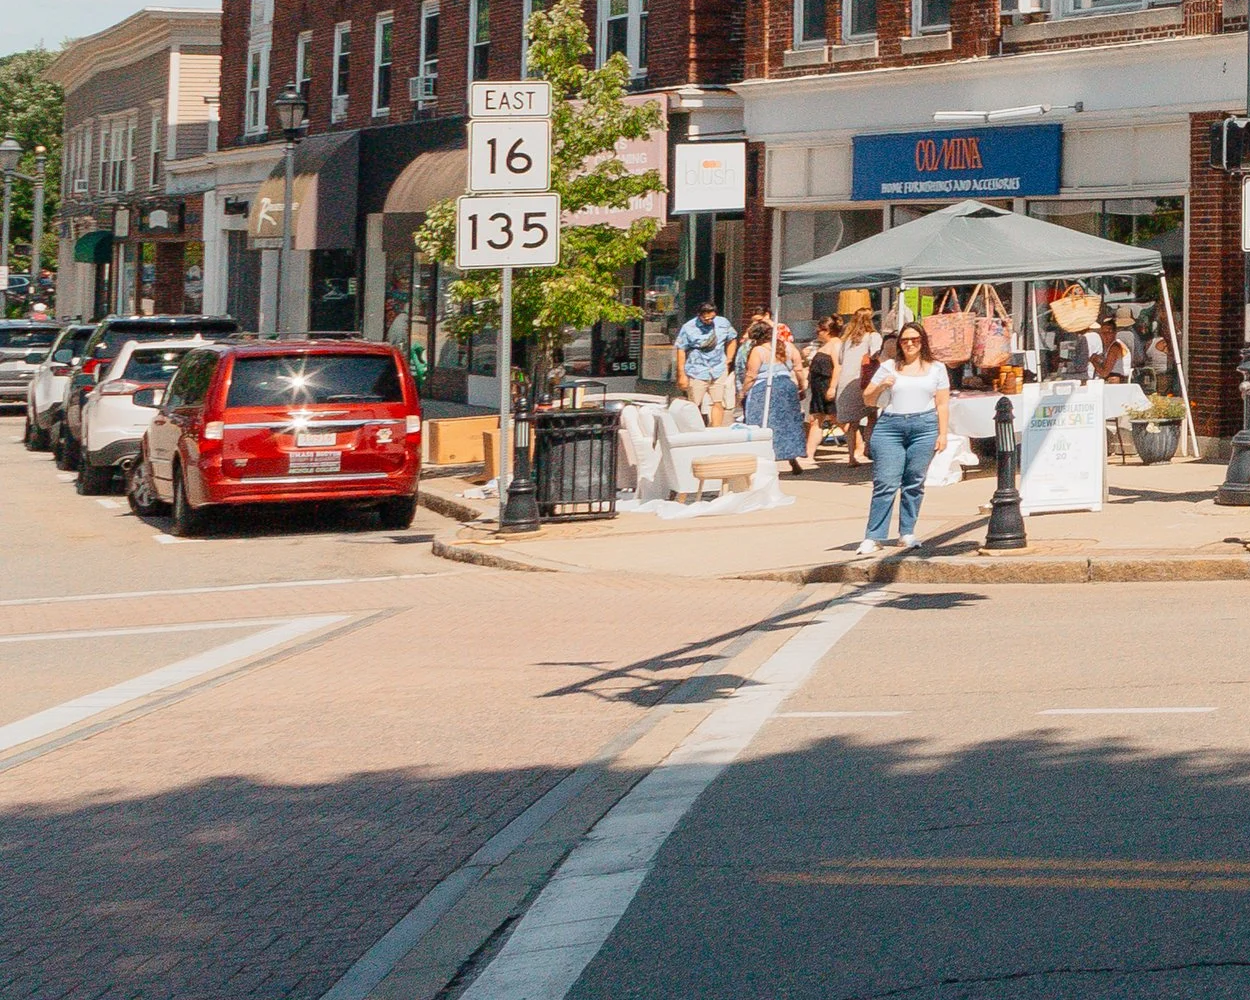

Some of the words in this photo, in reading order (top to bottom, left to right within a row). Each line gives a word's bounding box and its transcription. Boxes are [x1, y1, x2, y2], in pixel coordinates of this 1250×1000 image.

[485, 90, 536, 110] EAST
[487, 137, 533, 175] 16
[685, 159, 736, 186] blush
[881, 182, 903, 194] HOME
[953, 179, 972, 191] AND
[468, 212, 548, 251] 135
